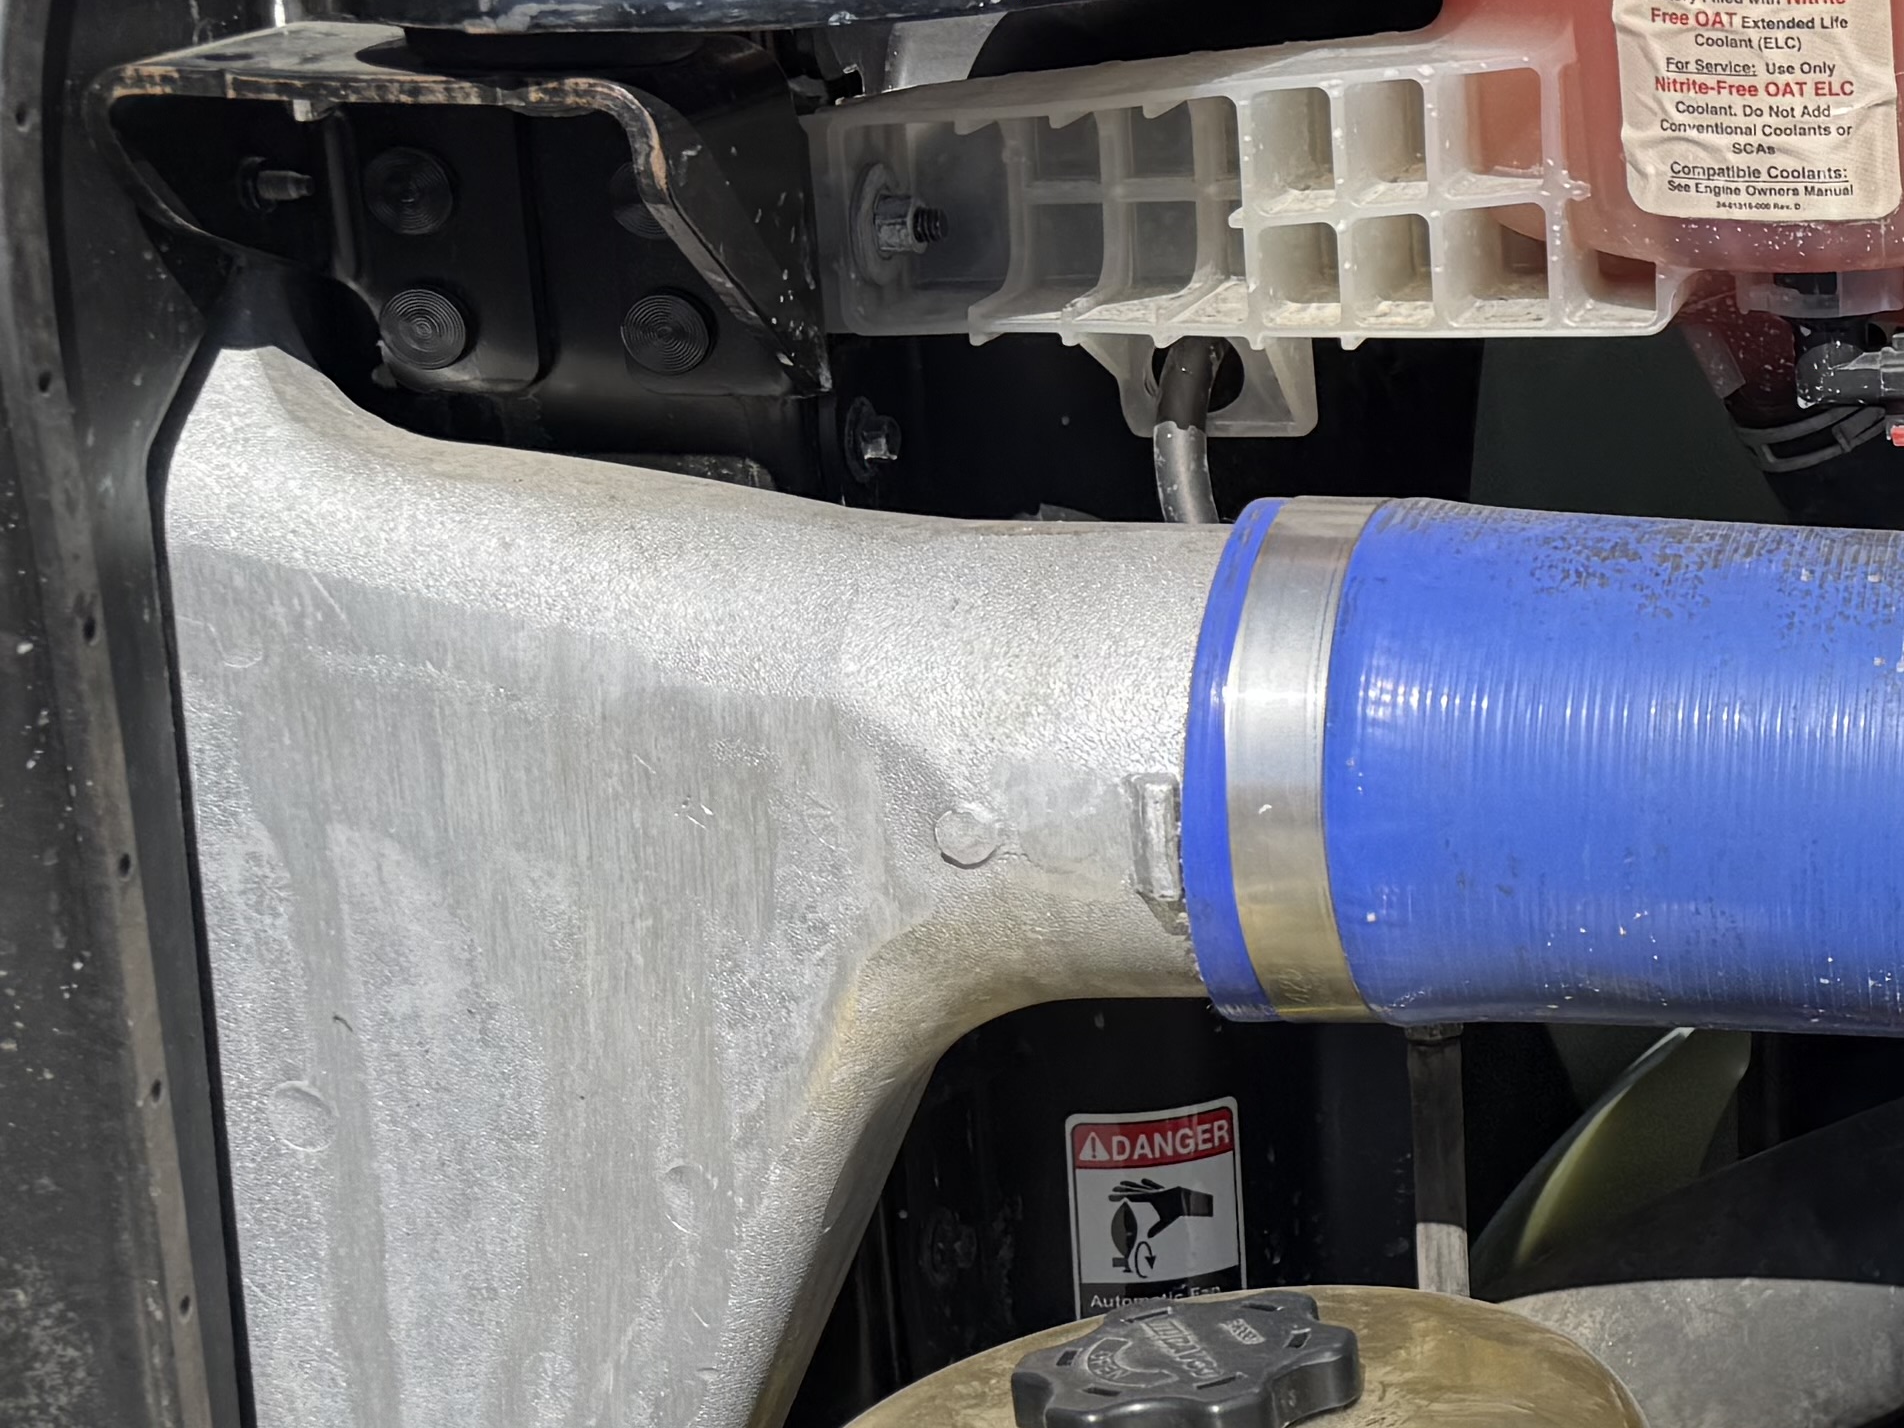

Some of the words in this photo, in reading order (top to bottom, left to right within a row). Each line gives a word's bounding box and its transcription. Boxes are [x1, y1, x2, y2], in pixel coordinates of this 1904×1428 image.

[1650, 8, 1689, 26] Free
[1695, 10, 1737, 28] OAT
[1741, 16, 1815, 30] Extended
[1820, 16, 1849, 29] Life
[1694, 33, 1754, 50] Coolant
[1758, 37, 1802, 52] (ELC)
[1666, 56, 1691, 72] For
[1695, 59, 1757, 74] Service:
[1765, 62, 1796, 75] Use
[1800, 62, 1836, 78] Only
[1654, 76, 1759, 97] Nitrite-Free
[1764, 80, 1808, 97] OAT
[1813, 80, 1855, 97] ELC
[1675, 101, 1738, 118] Coolant.
[1742, 105, 1764, 118] Do
[1768, 105, 1796, 118] Not
[1800, 104, 1831, 118] Add
[1660, 118, 1757, 137] Conventional
[1761, 123, 1832, 137] Coolants
[1836, 125, 1854, 137] or
[1731, 142, 1776, 156] SCAs
[1669, 161, 1762, 181] Compatible
[1766, 165, 1848, 180] Coolants:
[1667, 179, 1692, 193] See
[1695, 181, 1742, 198] Engine
[1745, 184, 1800, 197] Owners
[1803, 184, 1854, 198] Manual
[1111, 1119, 1230, 1162] DANGER
